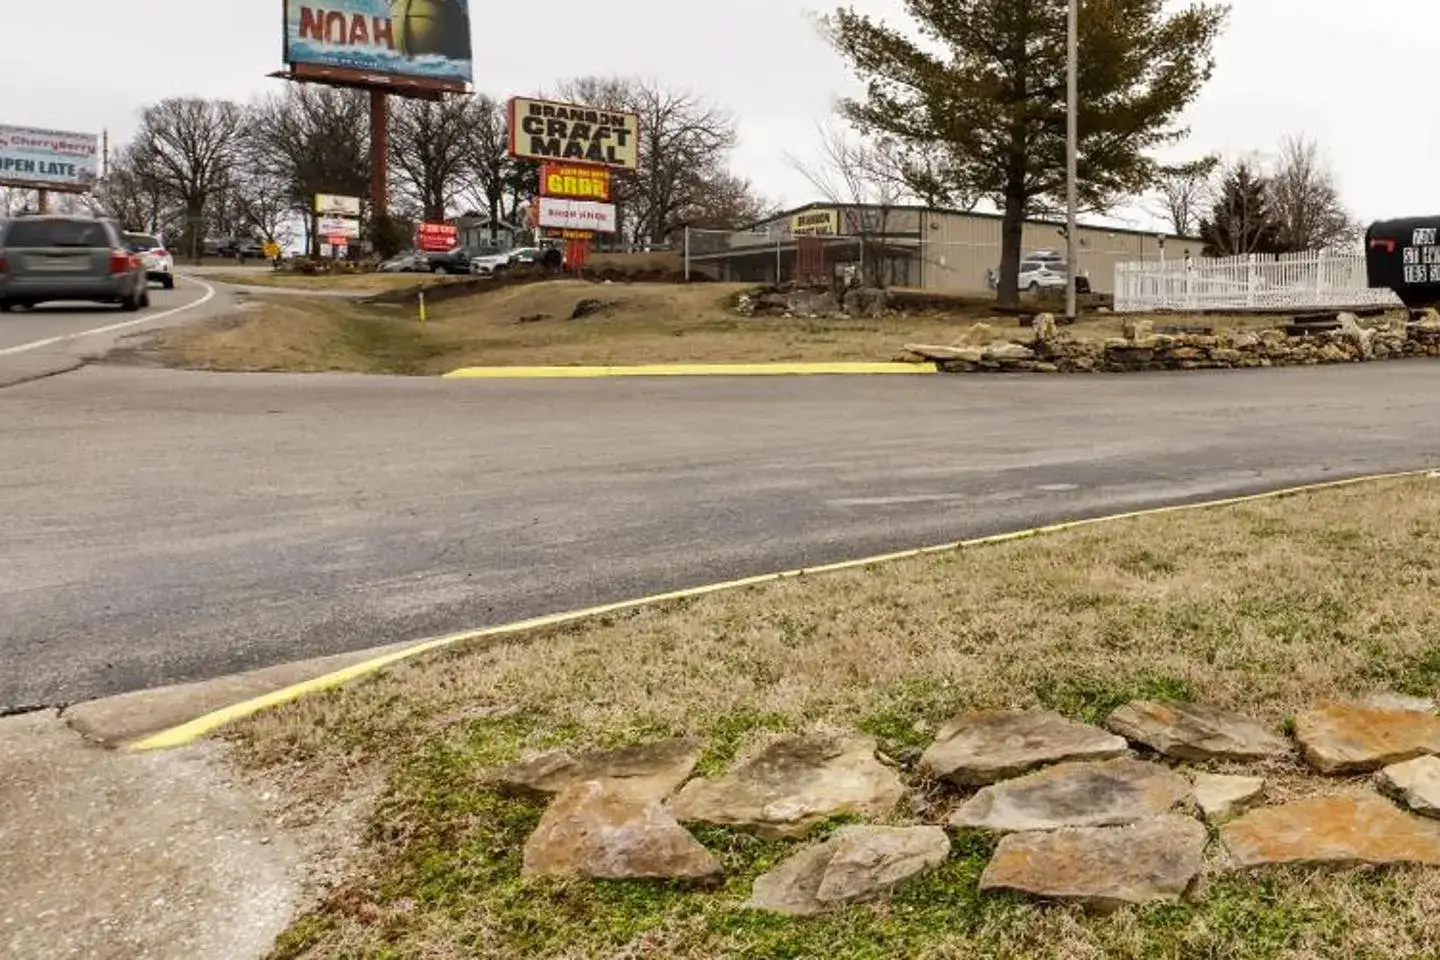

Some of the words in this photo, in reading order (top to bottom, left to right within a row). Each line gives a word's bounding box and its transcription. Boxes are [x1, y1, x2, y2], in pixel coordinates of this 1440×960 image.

[299, 5, 395, 50] NOAH
[522, 116, 631, 146] CRAFT
[39, 161, 78, 176] LATE
